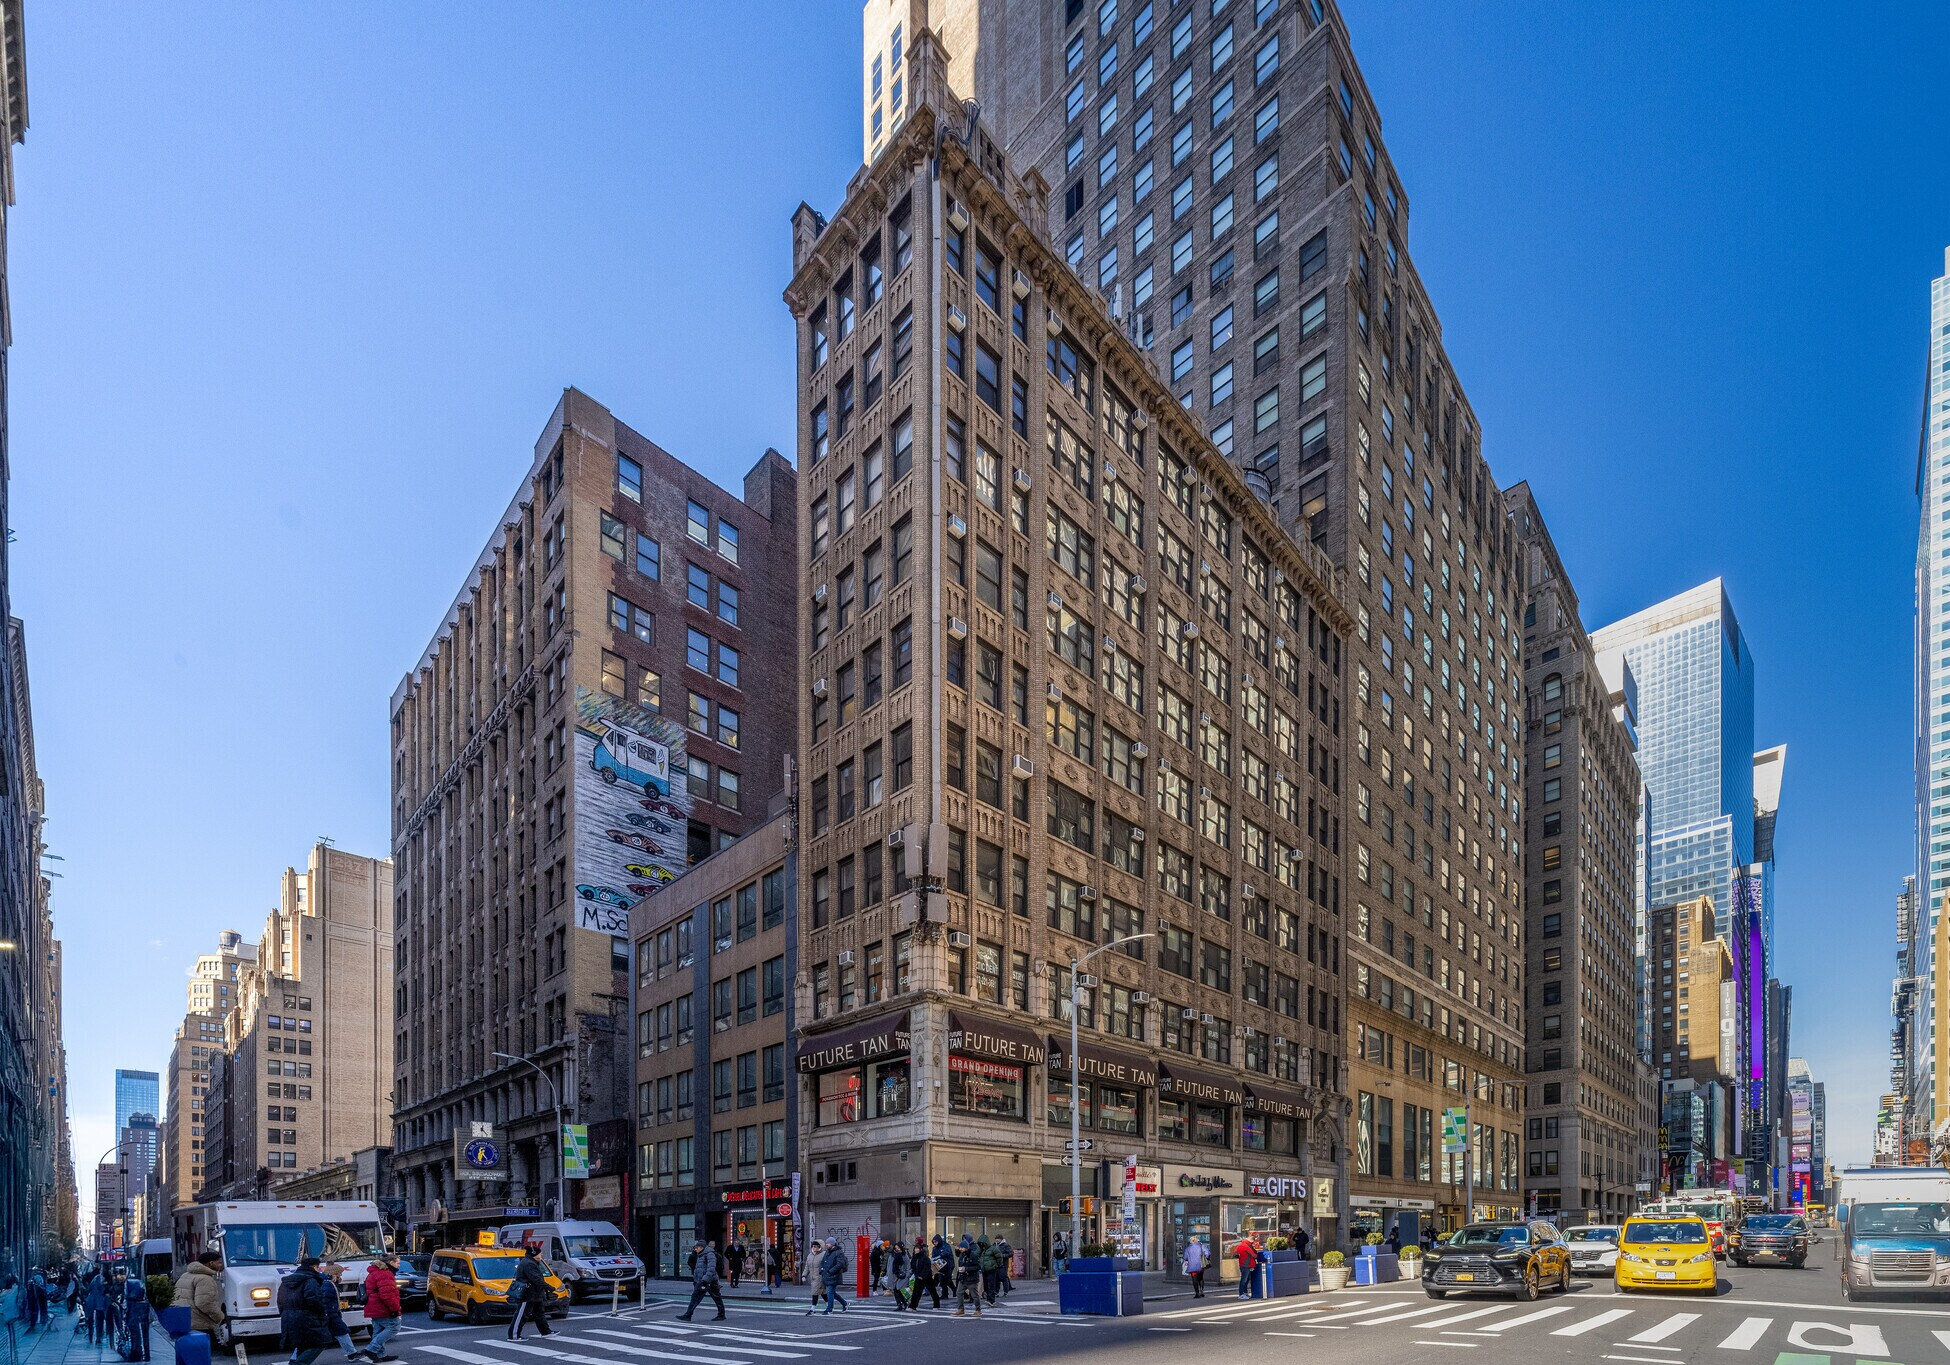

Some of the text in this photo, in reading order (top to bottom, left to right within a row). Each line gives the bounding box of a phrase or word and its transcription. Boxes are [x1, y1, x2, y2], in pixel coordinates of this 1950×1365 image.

[1720, 1018, 1735, 1036] 9
[800, 1034, 888, 1071] FUTURE TAN
[895, 1038, 912, 1050] TAN
[949, 1037, 963, 1049] TAN
[965, 1032, 1044, 1063] FUTURE TAN
[951, 1058, 1019, 1078] GRAND OPENING
[1131, 1068, 1155, 1086] TAN
[1176, 1079, 1242, 1104] FUTURE TAN
[1244, 1100, 1255, 1109] AN
[1258, 1098, 1311, 1119] FUTURE TAN
[1267, 1176, 1306, 1199] GIFTS
[588, 1258, 635, 1268] FedEx
